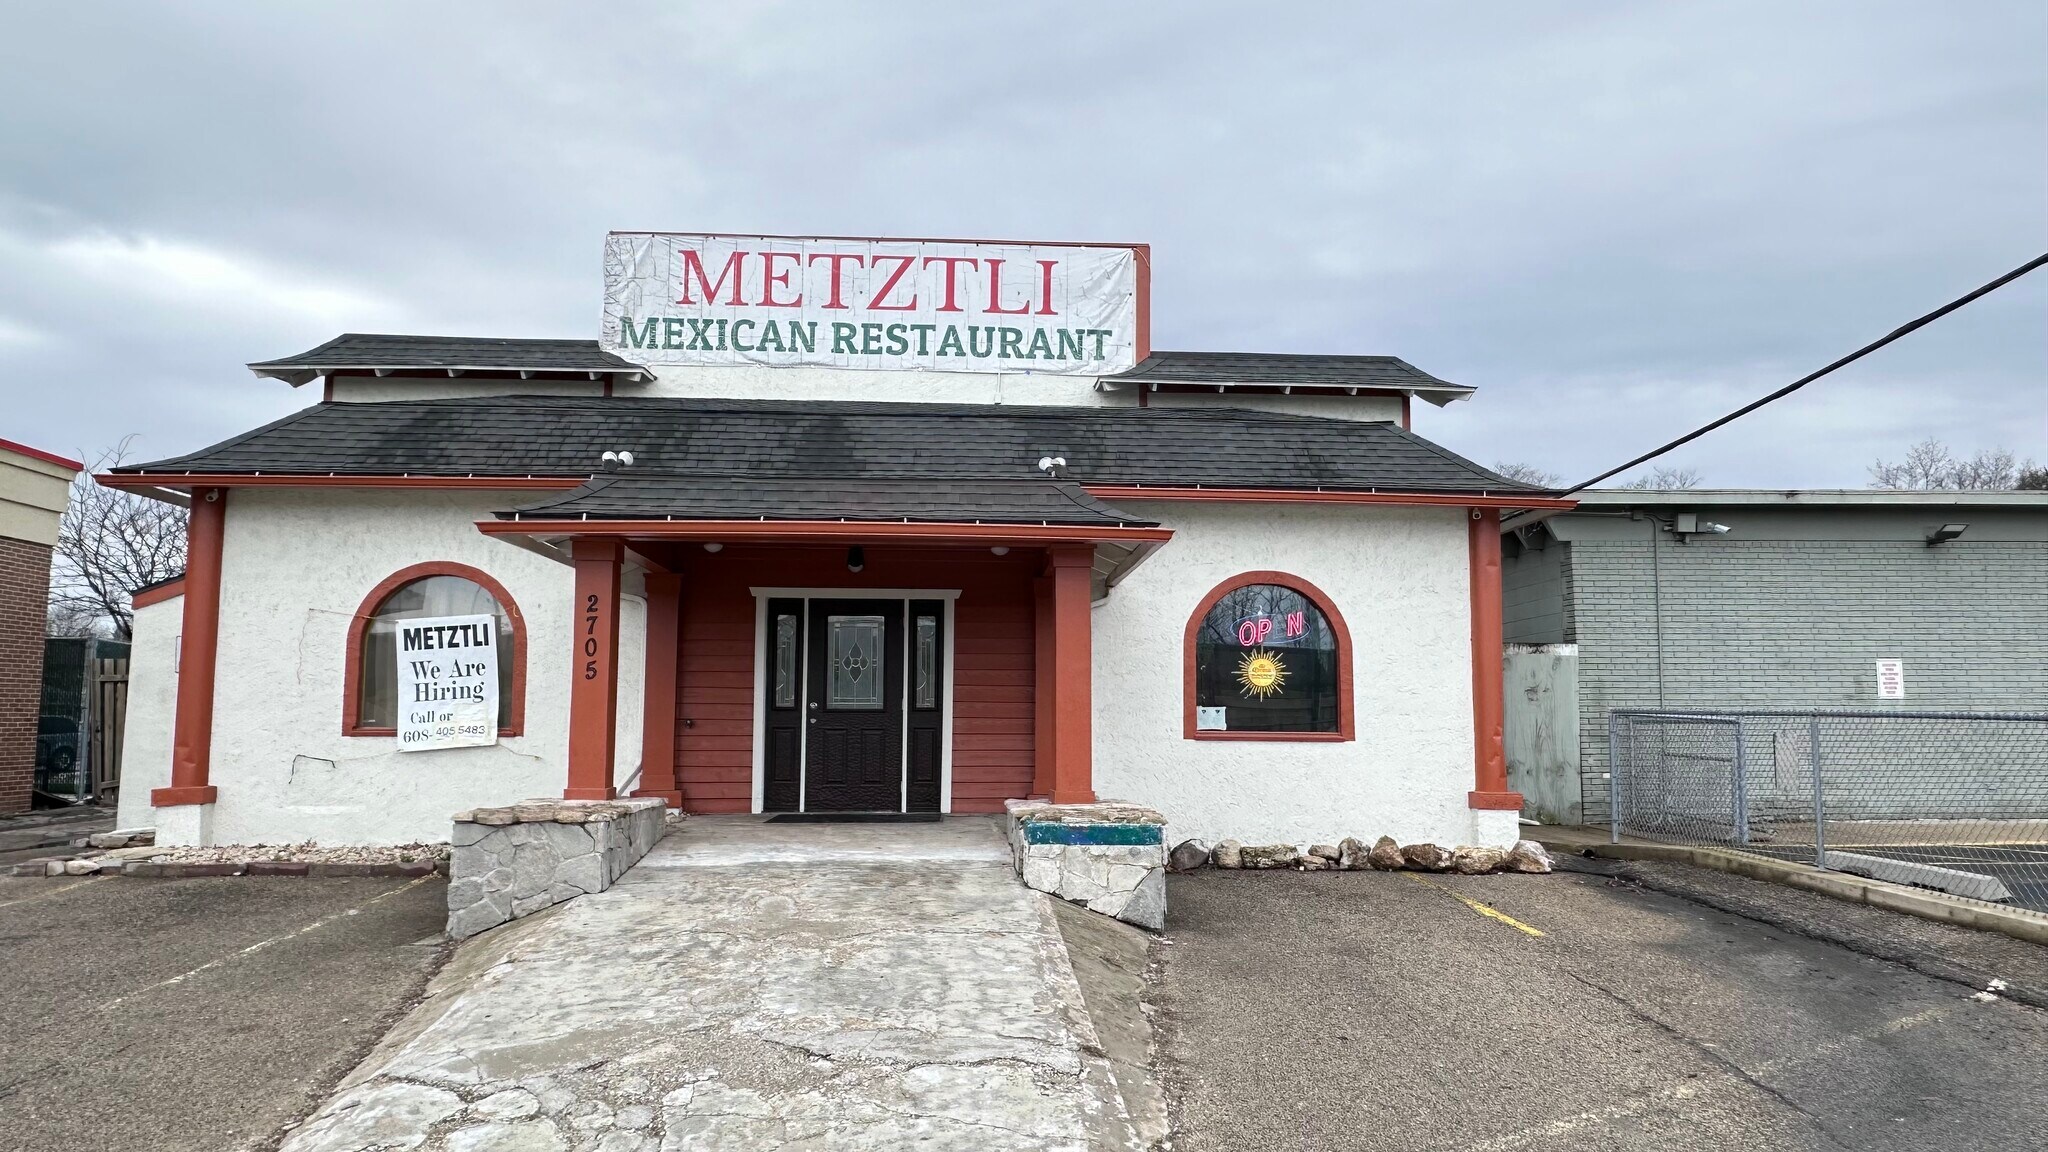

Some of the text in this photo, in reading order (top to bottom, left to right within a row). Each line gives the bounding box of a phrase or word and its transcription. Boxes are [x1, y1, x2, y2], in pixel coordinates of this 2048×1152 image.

[676, 249, 1059, 315] METZTLI
[619, 316, 1113, 361] MEXICAN RESTAURANT
[403, 623, 489, 651] METZTLI
[584, 594, 599, 681] 2705
[409, 659, 486, 680] We Are
[413, 680, 485, 703] Hiring
[410, 710, 454, 724] Call or
[458, 725, 486, 735] 5483
